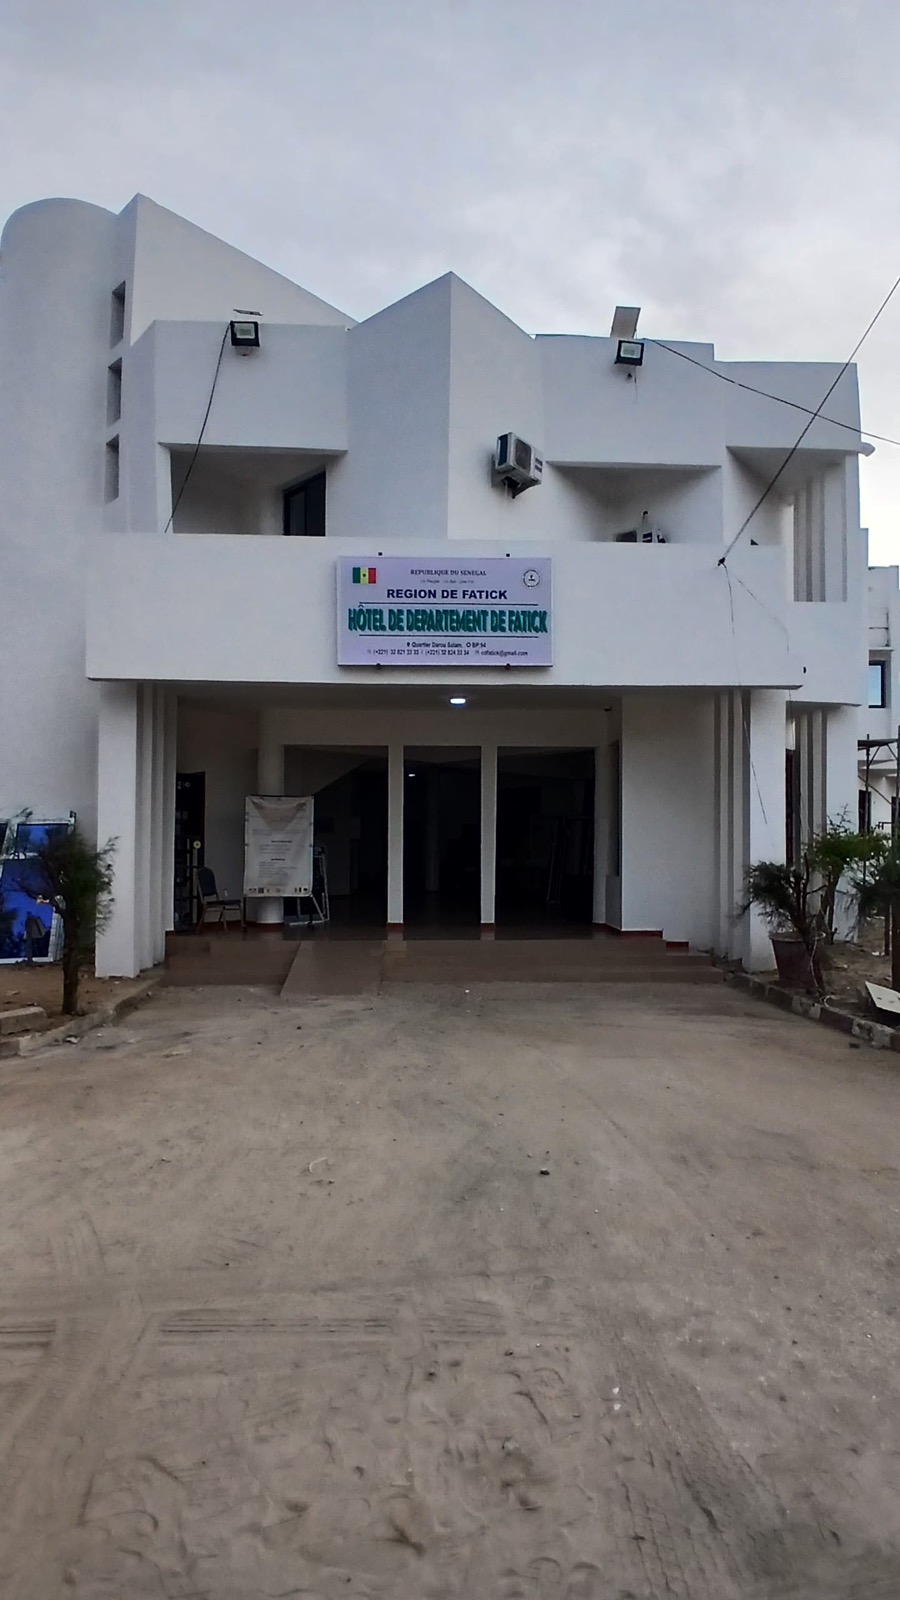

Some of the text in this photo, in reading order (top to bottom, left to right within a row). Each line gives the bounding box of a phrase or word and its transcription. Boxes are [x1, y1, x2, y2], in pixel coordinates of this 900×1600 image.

[386, 588, 508, 600] REGION DE FATICK
[348, 604, 548, 633] HÔTEL DE DEPARTEMENT DE FATICK
